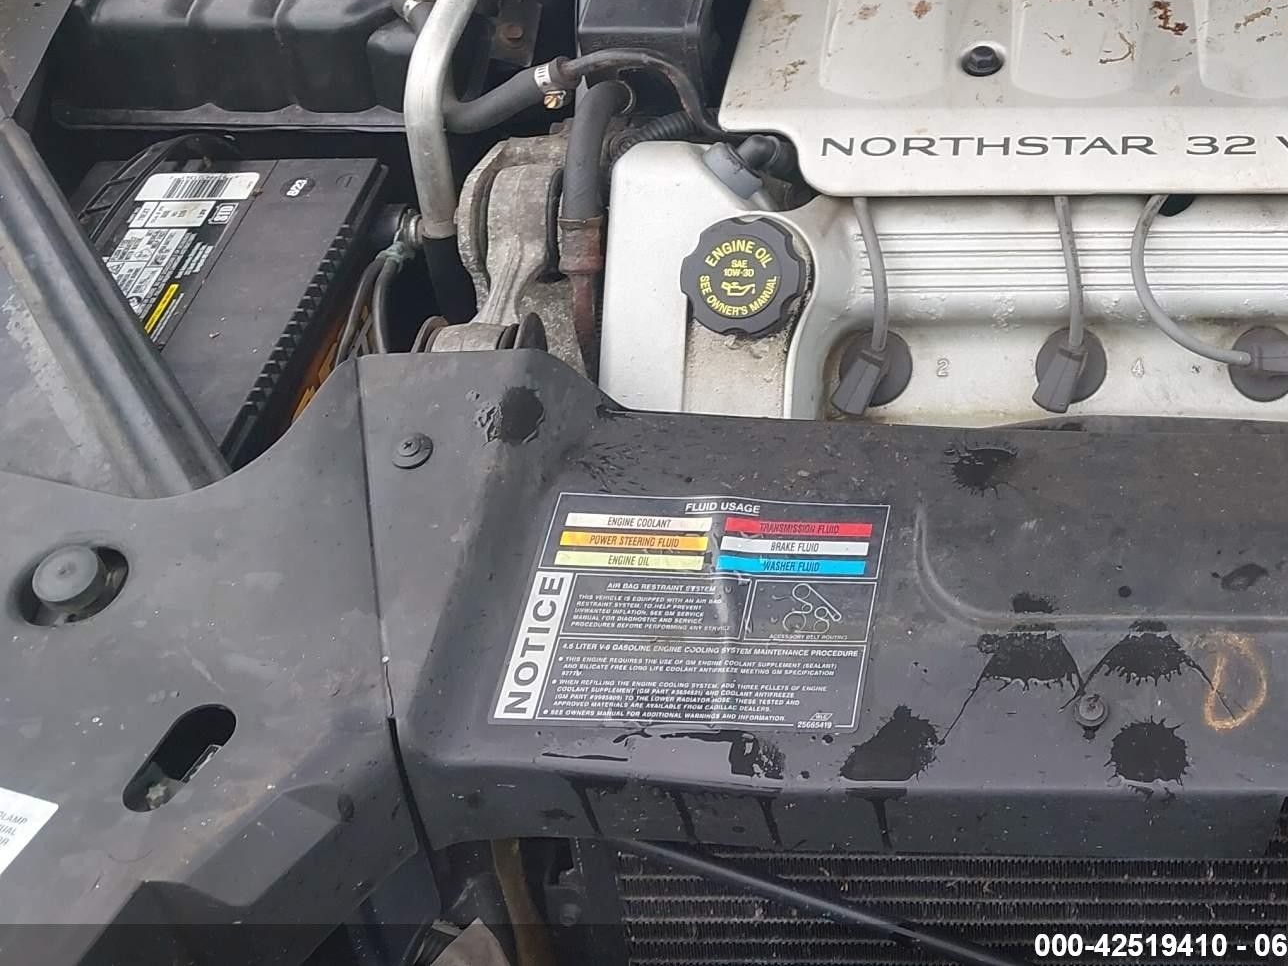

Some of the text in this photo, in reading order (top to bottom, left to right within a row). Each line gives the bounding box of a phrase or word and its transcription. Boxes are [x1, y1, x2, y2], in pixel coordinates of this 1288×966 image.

[820, 135, 1158, 156] NORTHSTAR
[1186, 135, 1258, 155] 32
[705, 240, 772, 268] ENGINE OIL
[731, 260, 748, 268] SAE
[724, 268, 754, 276] 10W-30
[700, 276, 777, 316] SEE OWNER'S MANUAL
[685, 502, 760, 513] FLUID USAGE
[608, 516, 671, 528] ENGINE COOLANT
[760, 523, 840, 534] TRANSMISSION FLUID
[590, 535, 680, 547] POWER STEERING FLUID
[770, 542, 819, 552] BRAKE FLUID
[608, 555, 650, 566] ENGINE OIL
[763, 561, 820, 571] WASHER FLUID
[503, 577, 564, 714] NOTICE
